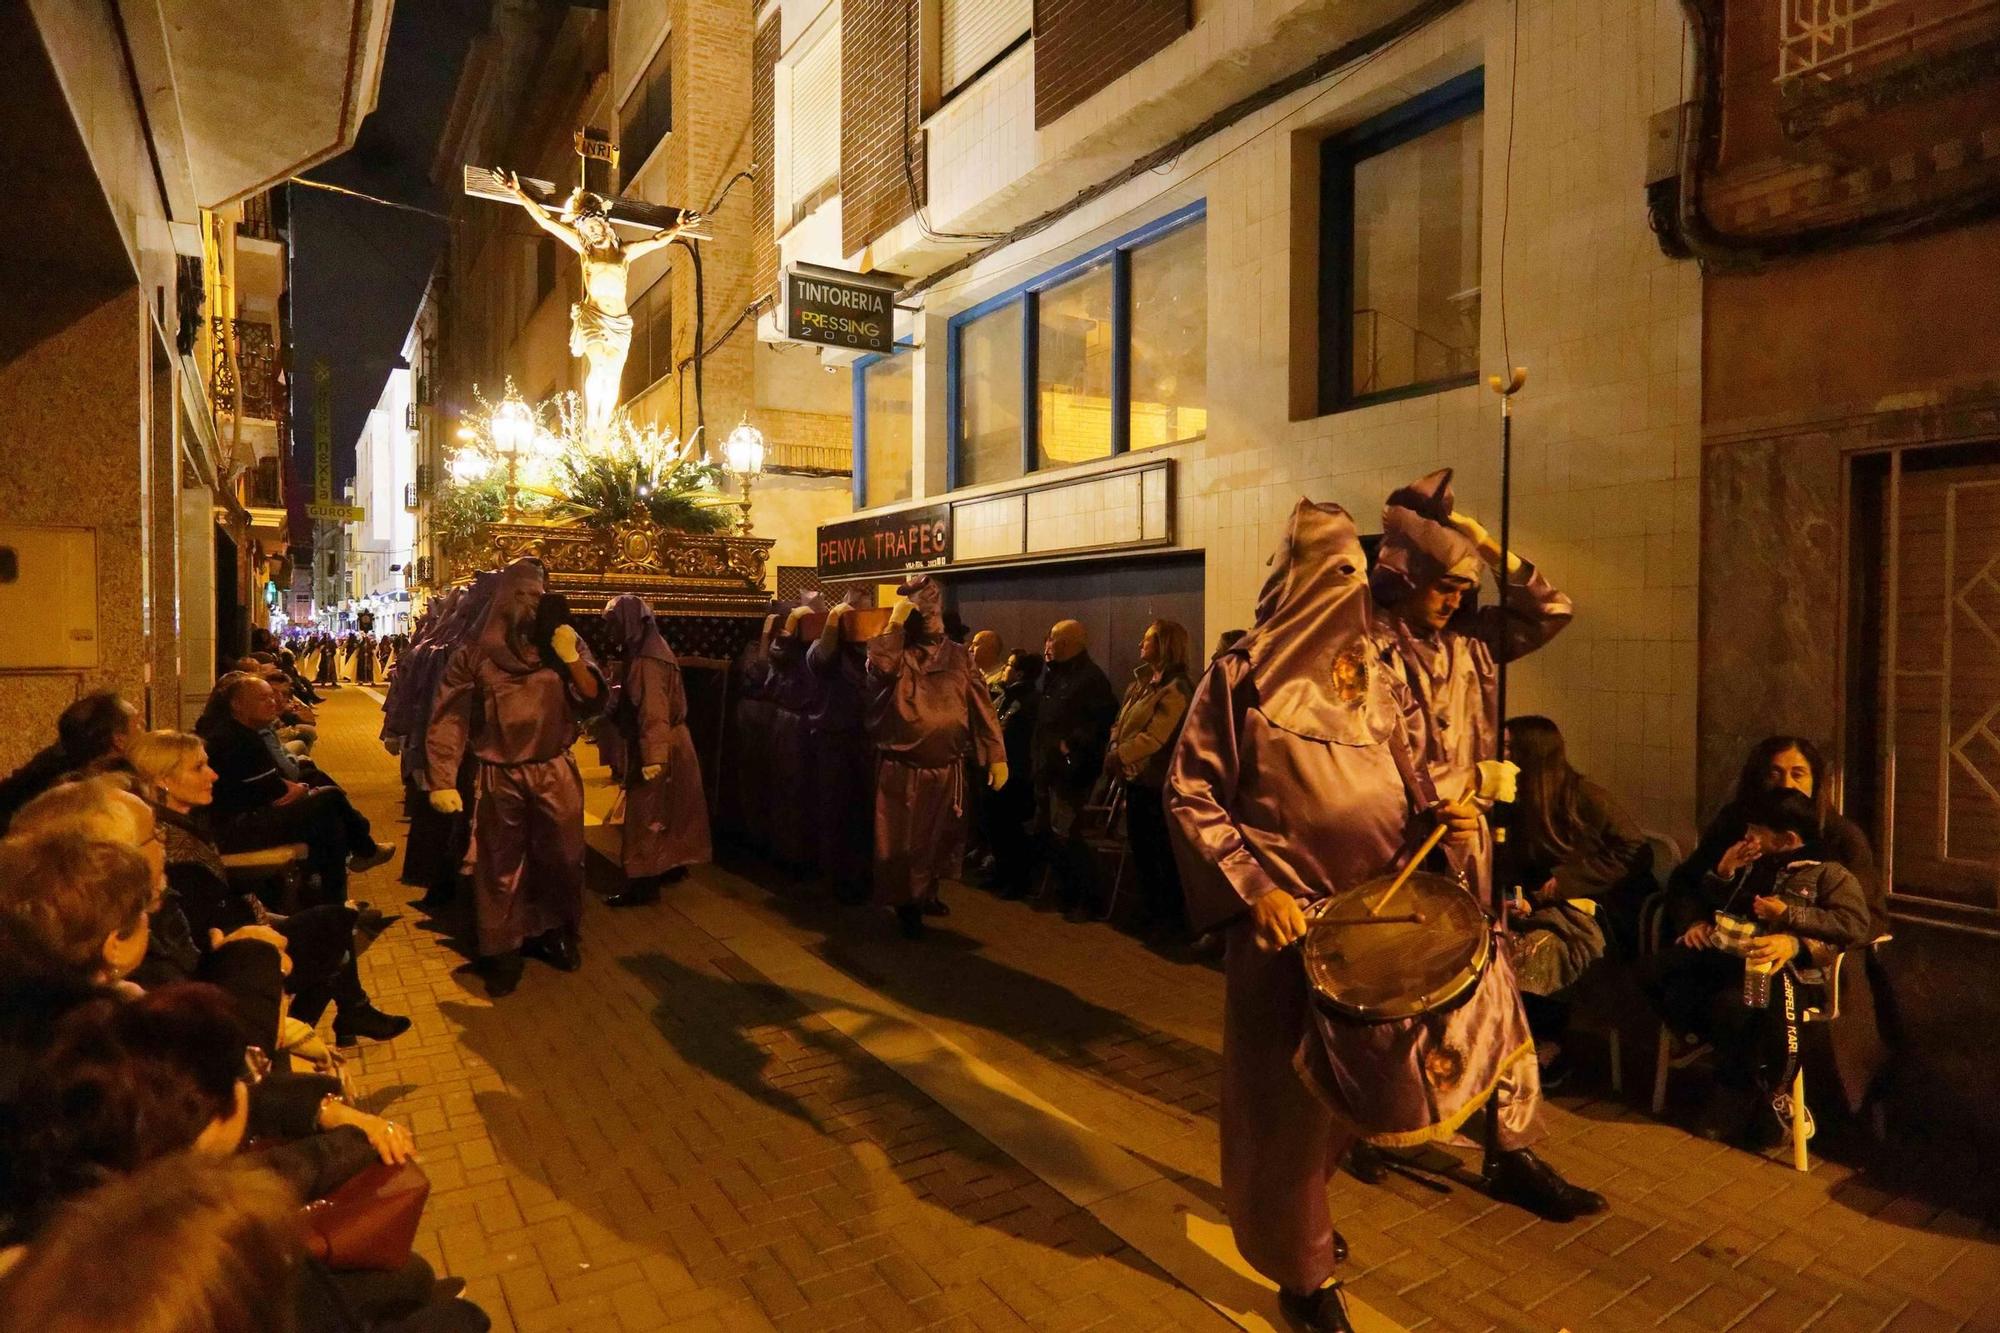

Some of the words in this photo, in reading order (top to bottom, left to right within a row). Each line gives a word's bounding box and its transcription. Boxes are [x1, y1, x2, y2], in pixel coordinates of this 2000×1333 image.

[582, 141, 611, 158] INRI
[797, 281, 884, 314] TINTORERIA
[801, 311, 880, 337] PRESSING
[820, 537, 867, 567] PENYA
